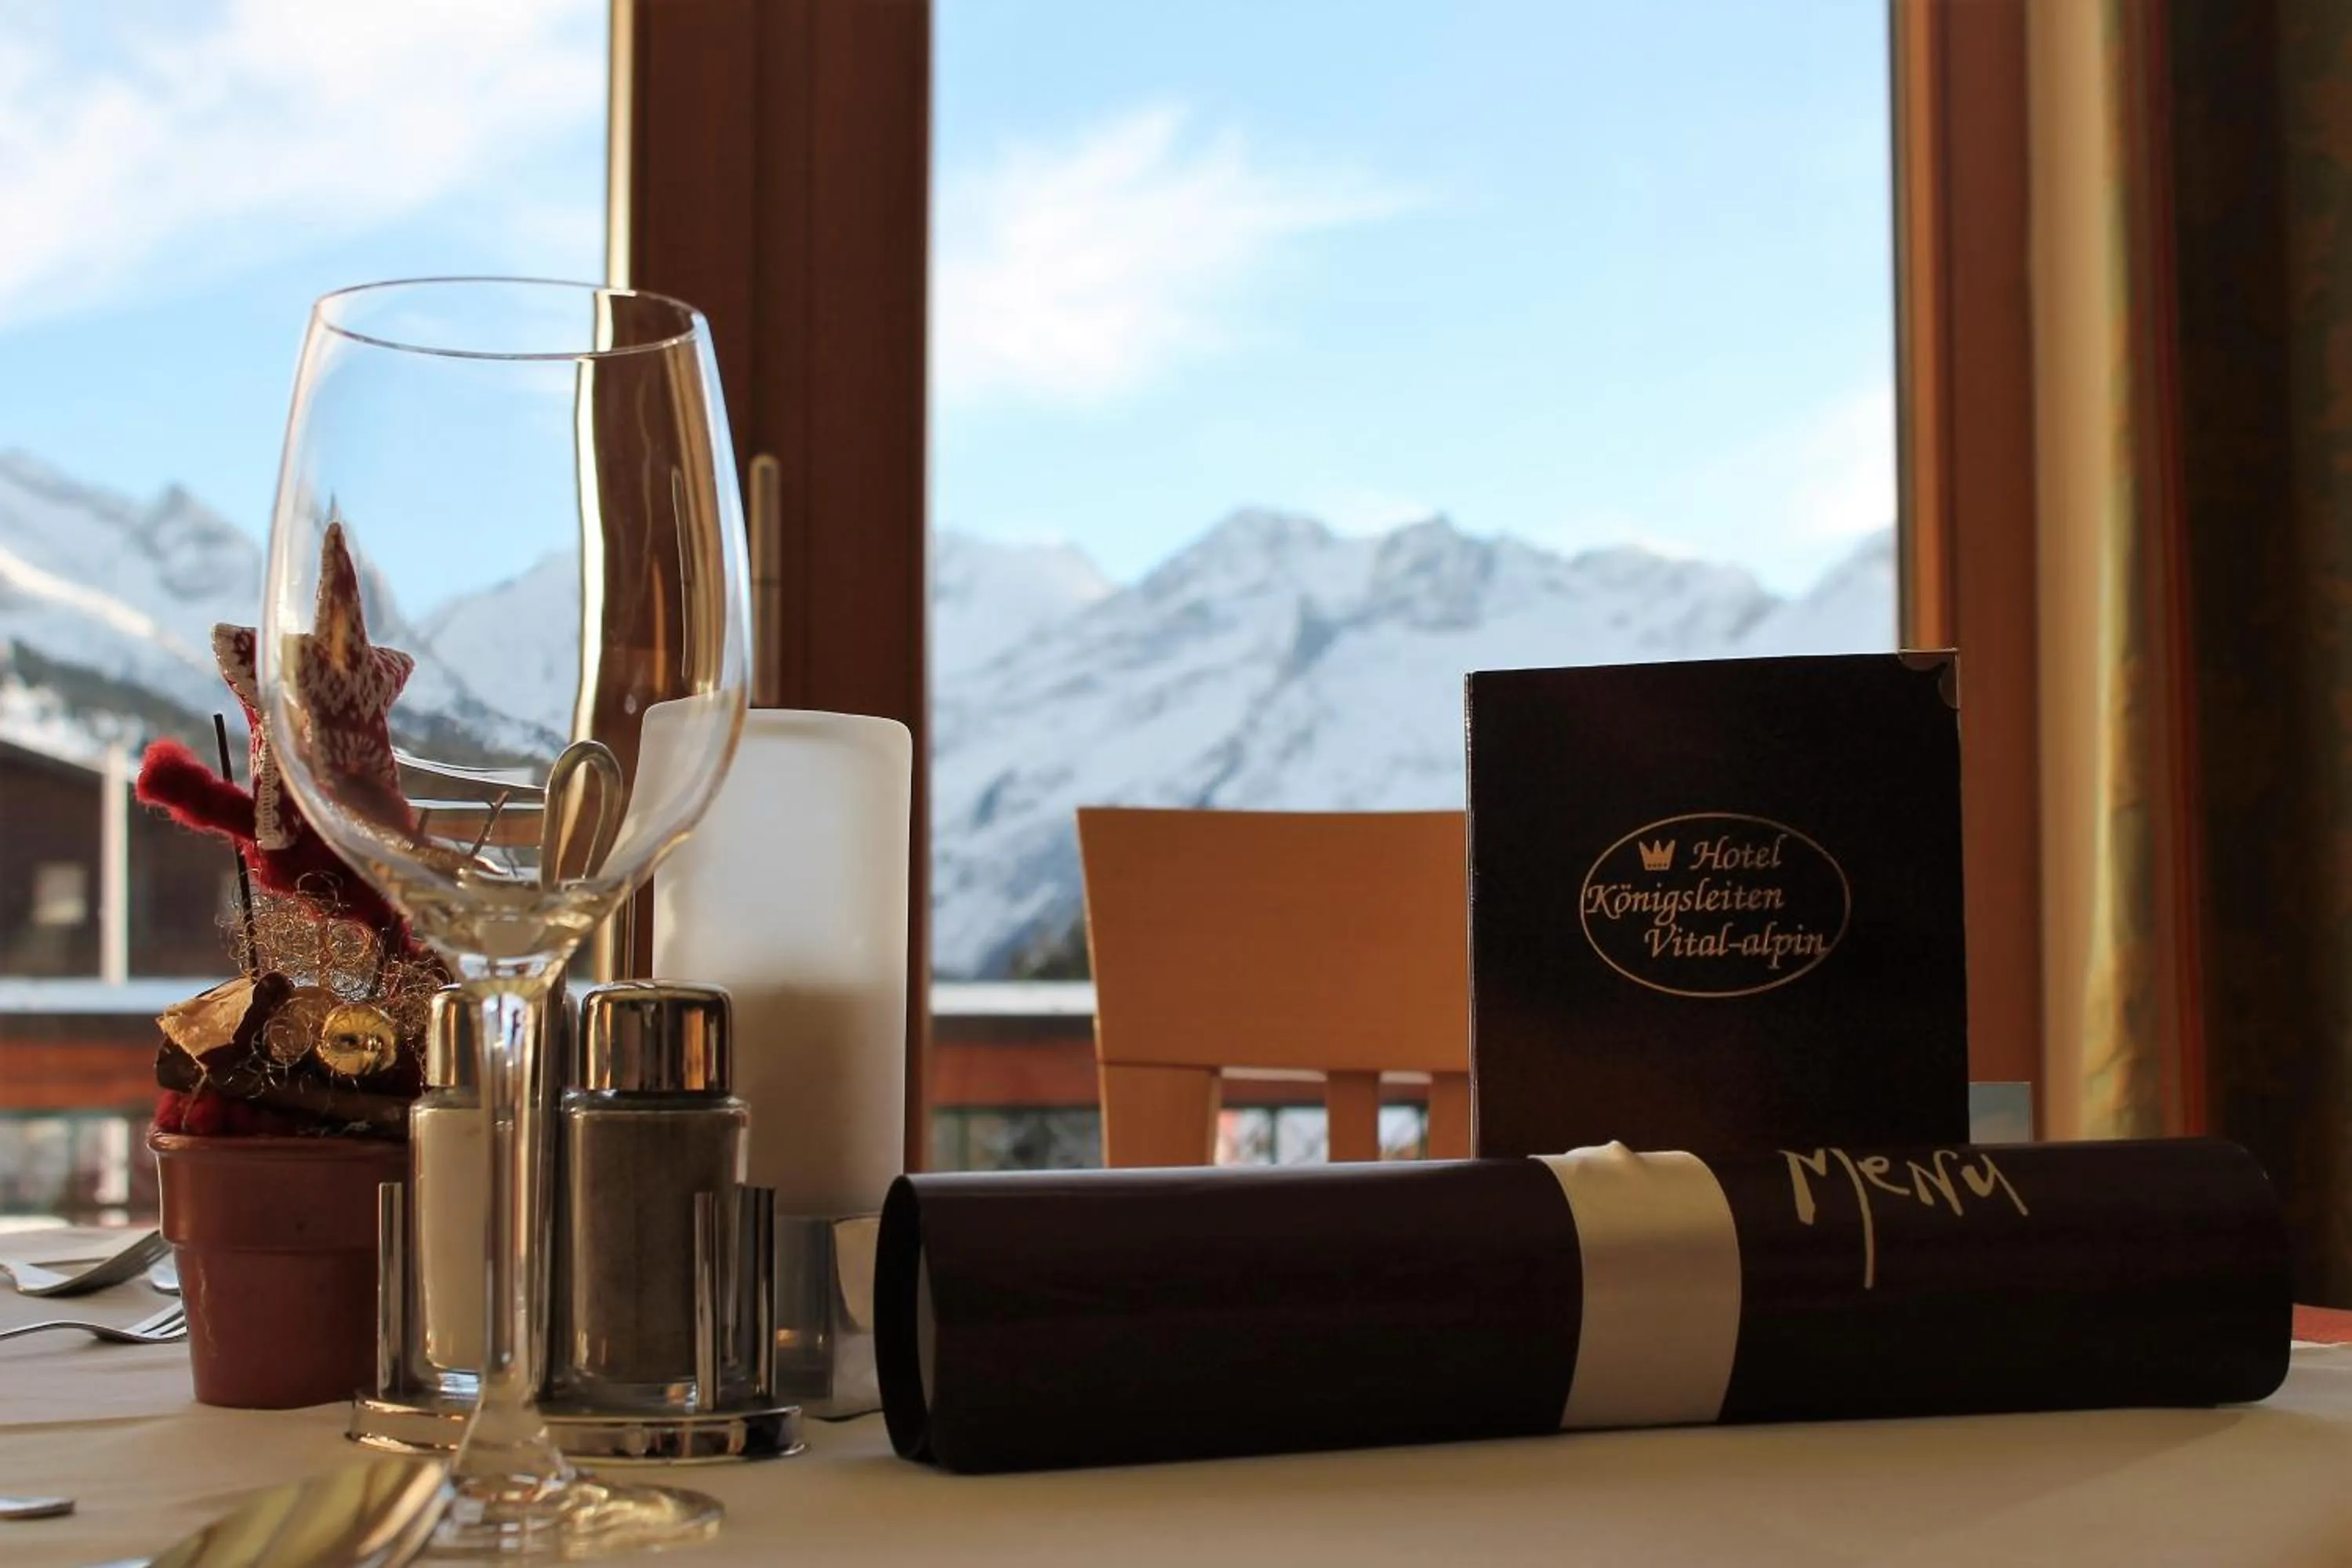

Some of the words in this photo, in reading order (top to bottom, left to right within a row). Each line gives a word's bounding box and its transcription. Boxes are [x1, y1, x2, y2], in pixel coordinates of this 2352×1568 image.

[1689, 833, 1788, 870] Hotel
[1584, 877, 1785, 927] Königsleiten
[1644, 920, 1828, 970] Vital-alpin
